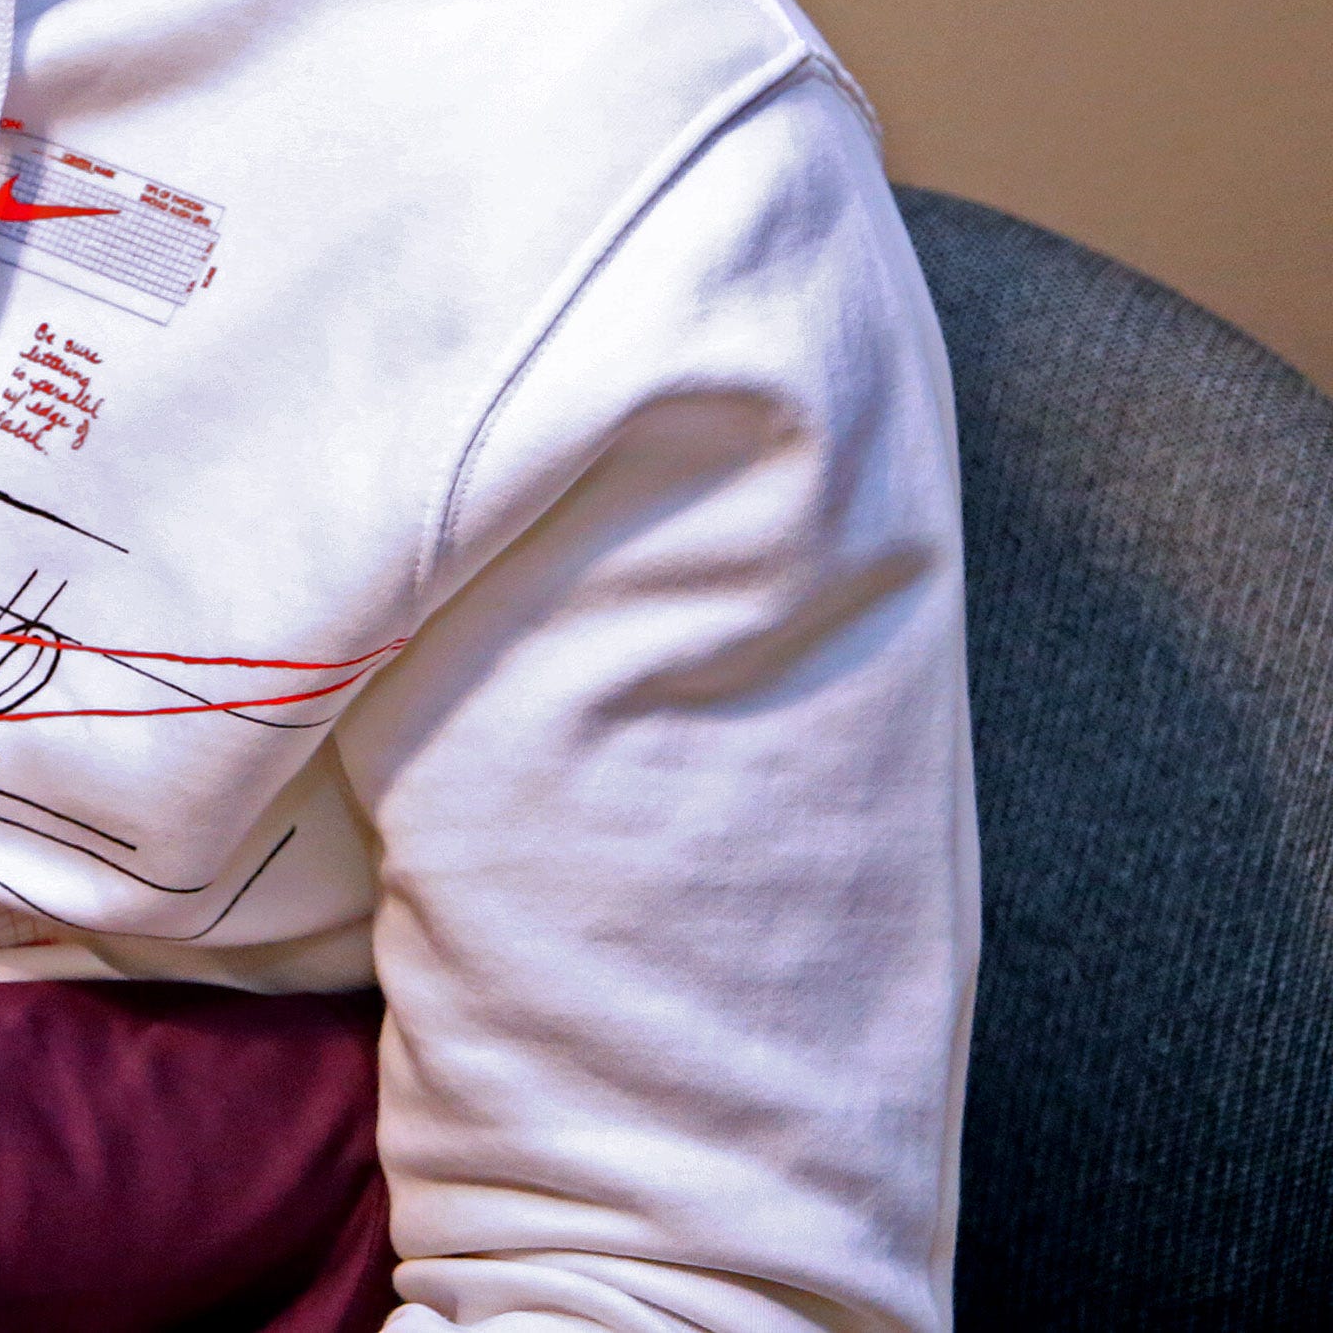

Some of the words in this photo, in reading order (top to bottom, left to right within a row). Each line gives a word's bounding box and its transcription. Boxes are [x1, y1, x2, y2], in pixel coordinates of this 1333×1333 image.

[34, 322, 55, 345] Be
[63, 339, 103, 365] sure
[19, 345, 90, 390] lettering
[25, 401, 71, 434] edge
[29, 378, 104, 420] parallel
